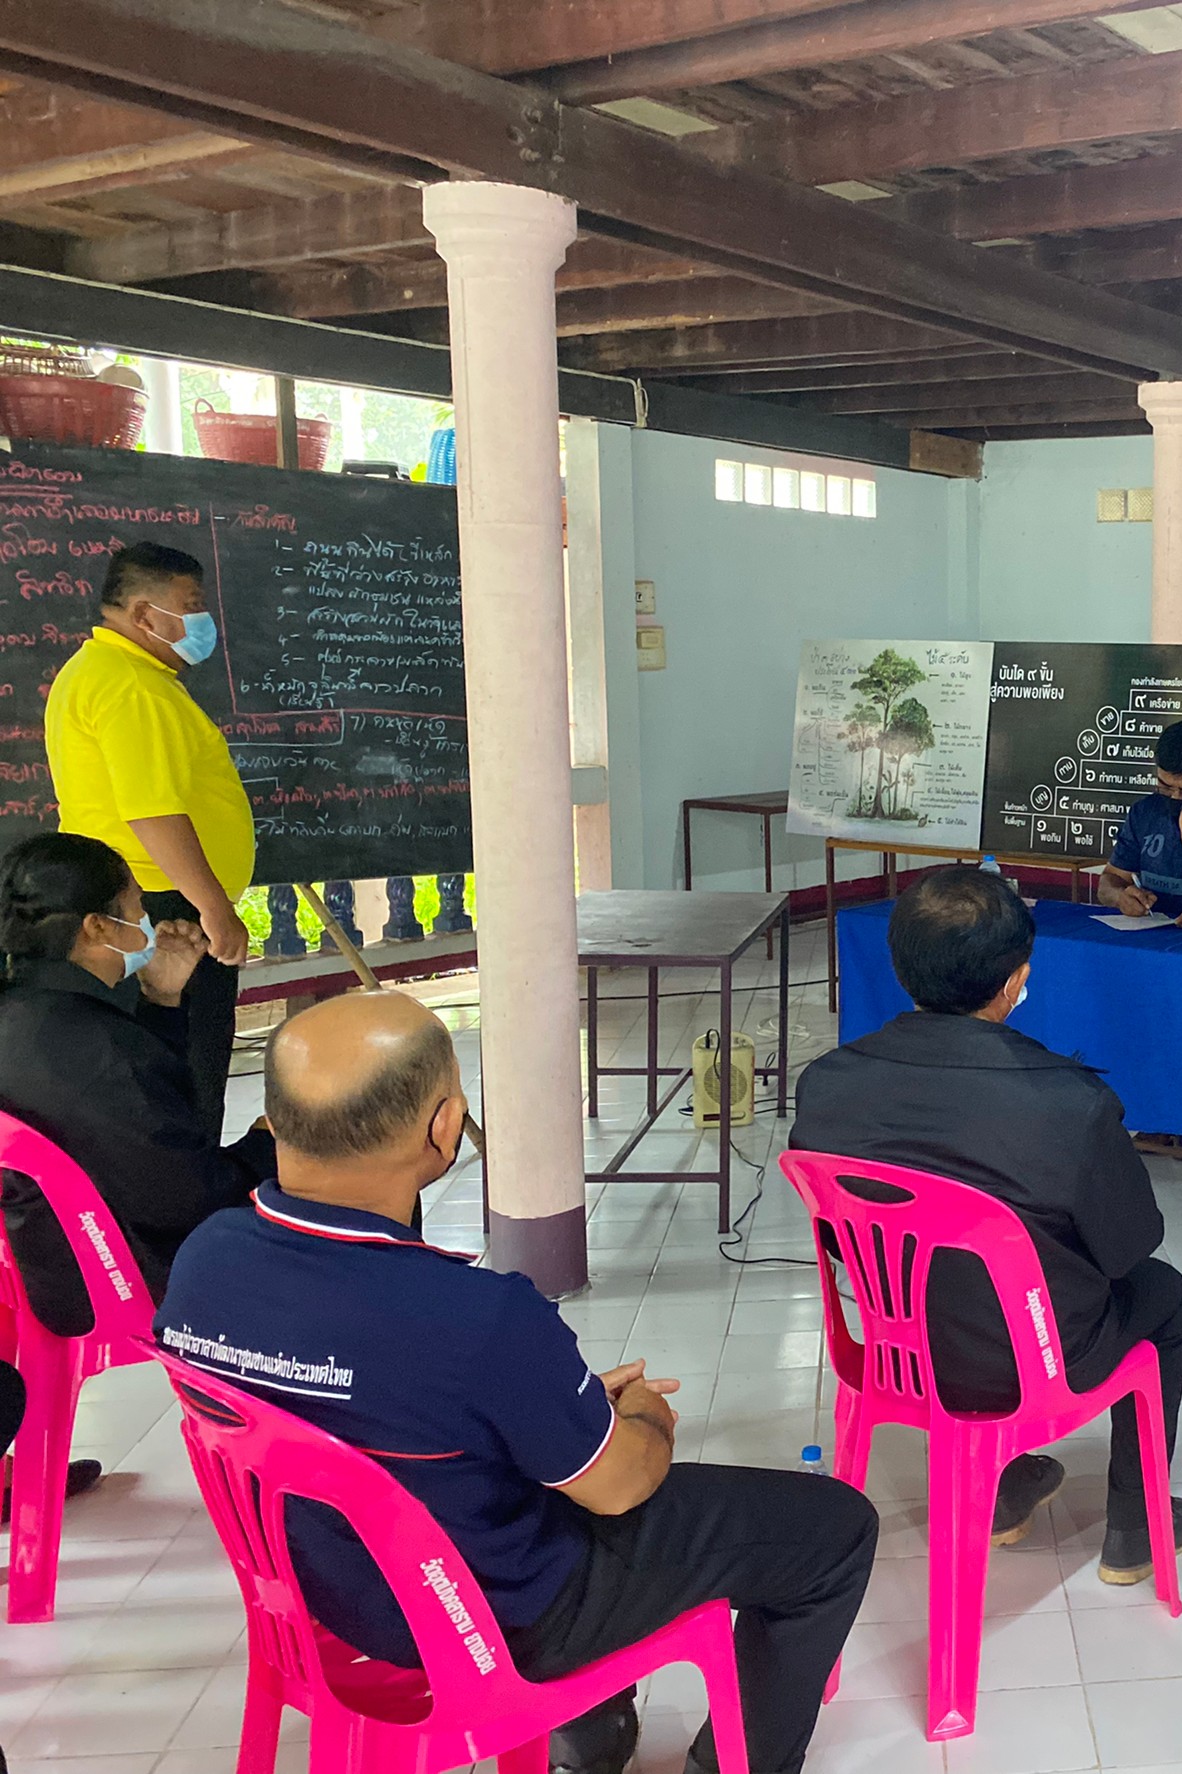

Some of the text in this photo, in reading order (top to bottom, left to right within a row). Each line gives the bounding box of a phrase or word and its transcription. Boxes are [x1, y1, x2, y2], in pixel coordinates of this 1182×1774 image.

[999, 664, 1024, 681] บันได
[1040, 661, 1053, 682] ขั้น
[990, 683, 1064, 703] สู่ความพอเพียง
